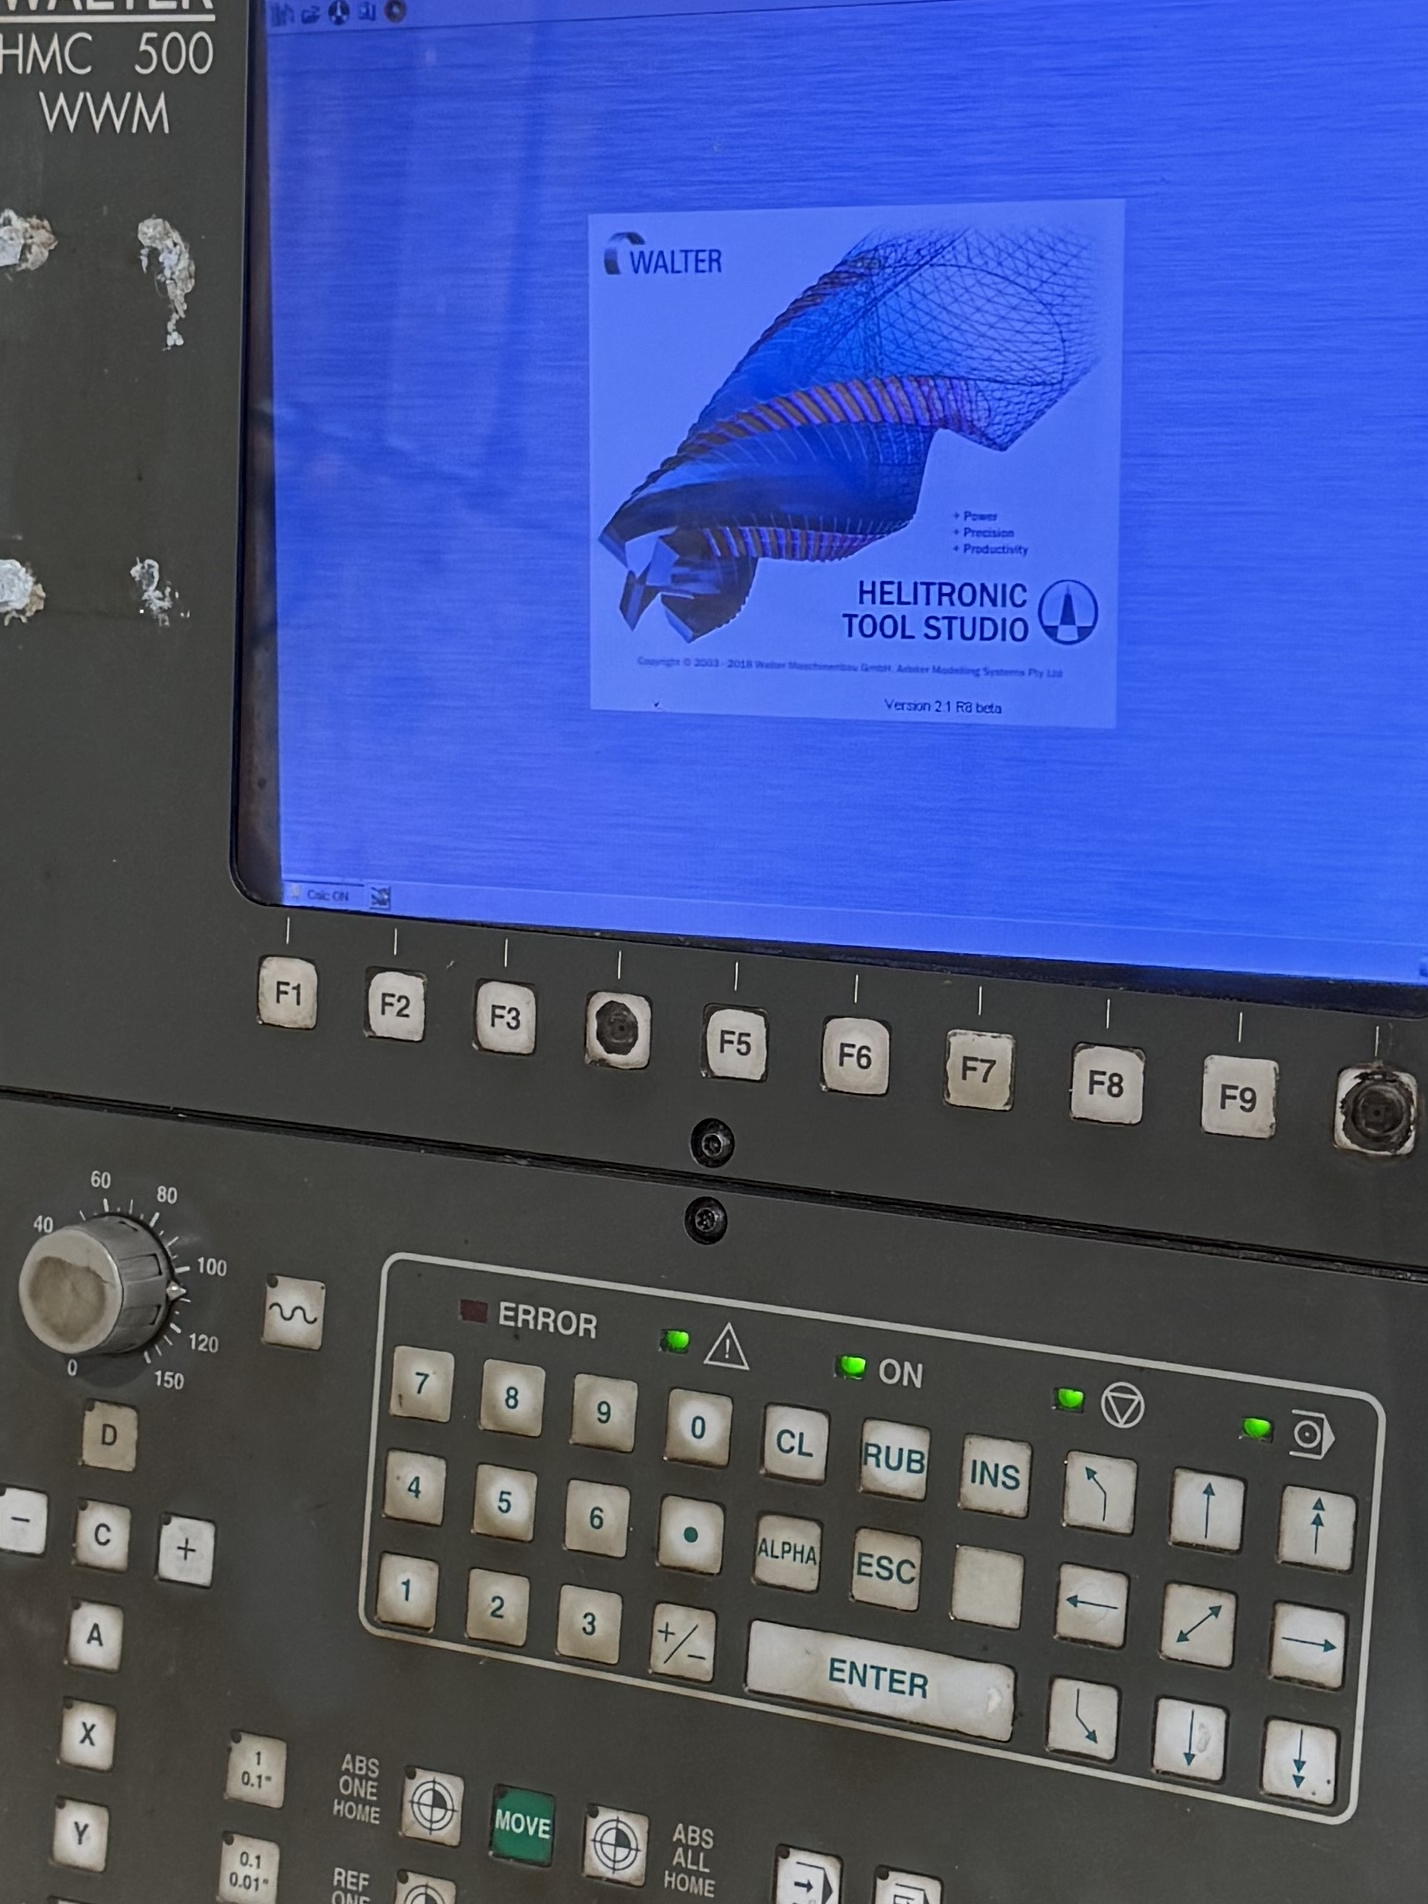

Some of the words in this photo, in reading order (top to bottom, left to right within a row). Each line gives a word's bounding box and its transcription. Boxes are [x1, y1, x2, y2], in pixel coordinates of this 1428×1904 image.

[134, 31, 214, 75] 500
[39, 91, 170, 135] WWM
[630, 248, 723, 275] WALTER
[963, 528, 1015, 538] Precision
[963, 544, 1029, 556] Productivity
[858, 580, 1028, 608] HELITRONIC
[842, 613, 916, 640] TOOL
[923, 615, 1029, 642] STUDIO
[884, 698, 931, 712] Version
[935, 701, 951, 712] 2.1
[976, 702, 1002, 714] beta
[275, 980, 303, 1006] F1
[380, 993, 411, 1018] F2
[490, 1004, 521, 1030] F3
[719, 1030, 752, 1056] F5
[838, 1043, 872, 1071] F6
[961, 1056, 997, 1084] F7
[1087, 1070, 1124, 1098] F8
[1219, 1083, 1257, 1114] F9
[90, 1171, 111, 1189] 60
[156, 1186, 178, 1204] 80
[33, 1214, 54, 1234] 40
[197, 1257, 227, 1277] 100
[498, 1301, 598, 1339] ERROR
[189, 1333, 219, 1354] 120
[154, 1370, 184, 1390] 150
[414, 1372, 430, 1395] 7
[879, 1357, 923, 1388] ON
[504, 1386, 519, 1409] 8
[596, 1401, 612, 1424] 9
[101, 1424, 117, 1446] D
[690, 1415, 706, 1440] 0
[775, 1429, 814, 1458] CL
[862, 1442, 926, 1476] RUB
[407, 1476, 421, 1498] 4
[971, 1459, 1021, 1492] INS
[497, 1491, 511, 1514] 5
[589, 1506, 604, 1530] 6
[94, 1523, 112, 1546] C
[757, 1536, 818, 1566] ALPHA
[856, 1551, 917, 1586] ESC
[400, 1579, 411, 1602] 1
[490, 1596, 505, 1619] 2
[86, 1623, 104, 1646] A
[582, 1612, 597, 1636] 3
[828, 1656, 930, 1699] ENTER
[79, 1721, 97, 1747] X
[341, 1753, 380, 1778] ABS
[339, 1775, 378, 1800] ONE
[333, 1799, 381, 1825] HOME
[73, 1821, 89, 1845] Y
[494, 1810, 552, 1840] MOVE
[672, 1823, 715, 1850] ABS
[239, 1852, 263, 1870] 0.1
[672, 1846, 711, 1873] ALL
[333, 1867, 370, 1891] REF
[664, 1870, 716, 1898] HOME
